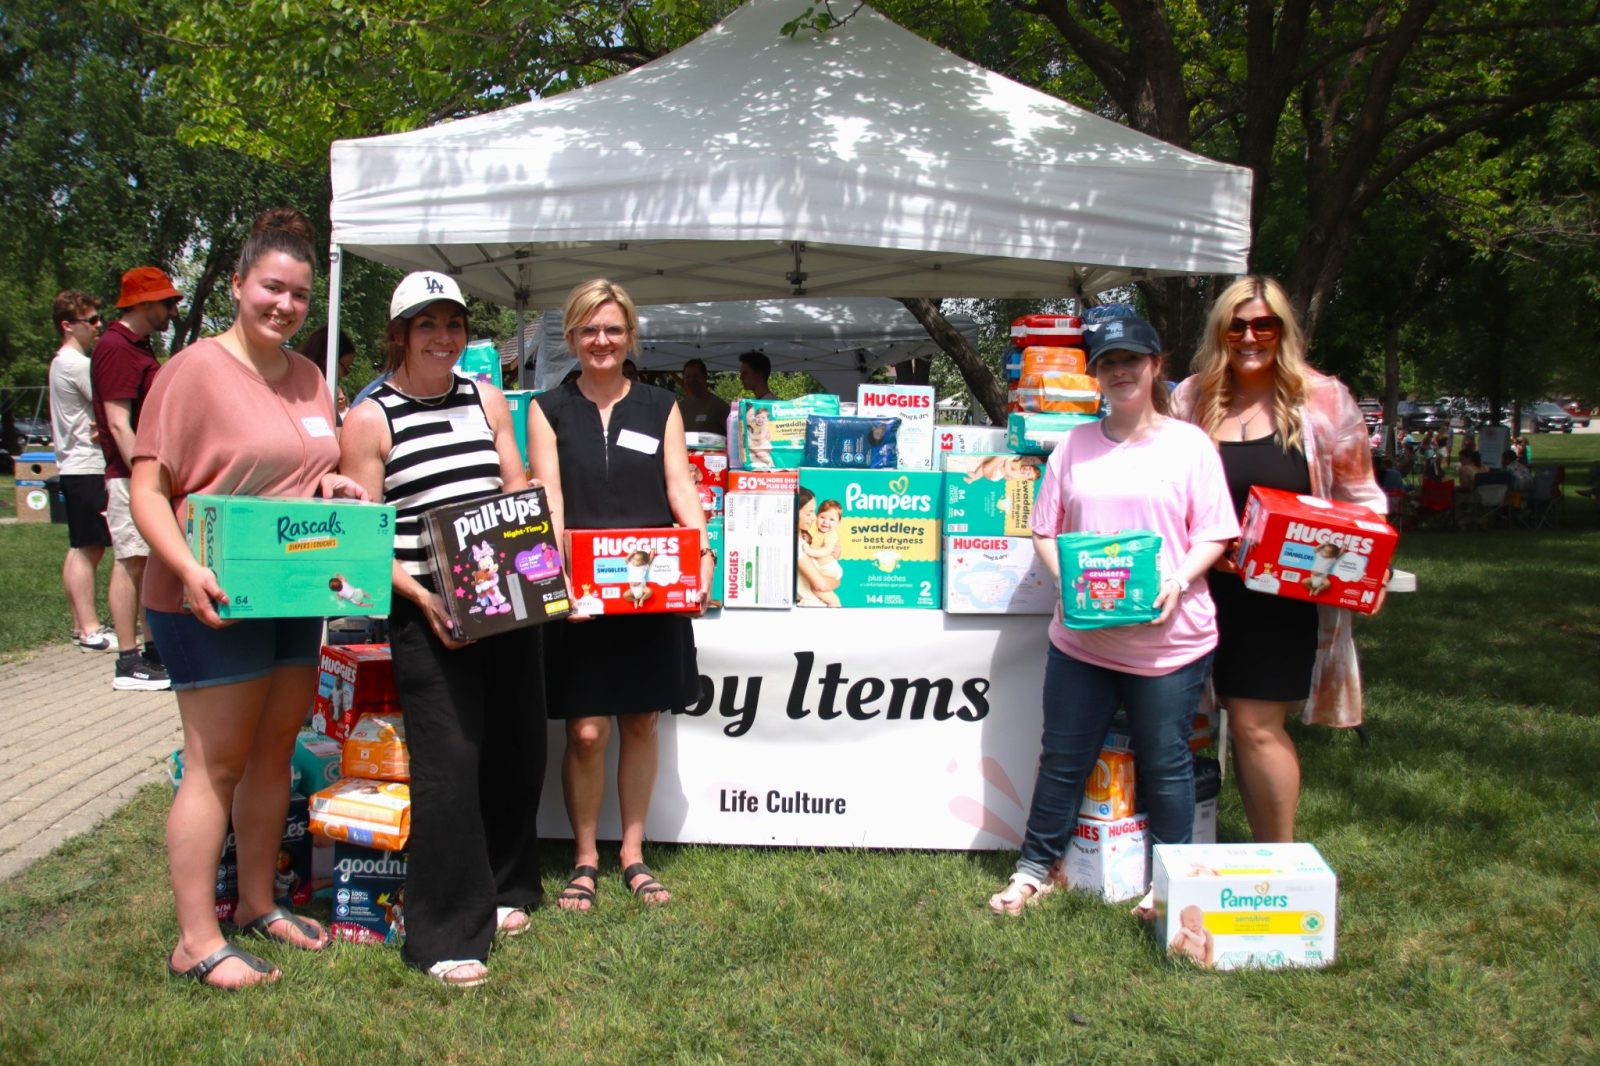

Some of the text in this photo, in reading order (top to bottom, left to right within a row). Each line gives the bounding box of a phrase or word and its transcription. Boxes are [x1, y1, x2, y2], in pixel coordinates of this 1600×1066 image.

[424, 276, 445, 294] LA
[864, 393, 930, 408] HUGGIES
[776, 421, 807, 430] swaddle
[811, 419, 828, 464] goodnites
[737, 476, 766, 489] 50%
[845, 482, 931, 515] Pampers
[1021, 480, 1030, 528] swaddlers
[277, 511, 343, 545] Rascals
[379, 513, 389, 528] 3
[850, 523, 925, 535] swaddlers
[204, 507, 218, 577] Rasca
[593, 536, 680, 556] HUGGIES
[887, 537, 924, 545] dryness
[952, 538, 1007, 550] HUGGIES
[1285, 522, 1374, 555] HUGGIES
[1078, 550, 1134, 570] Pampers
[728, 551, 739, 599] HUGGIES
[543, 592, 553, 602] 52
[685, 589, 697, 603] N
[920, 581, 932, 597] 2
[1361, 590, 1374, 604] N
[235, 595, 248, 605] 64
[866, 594, 883, 604] 144
[321, 655, 357, 684] HUGGIES
[786, 651, 990, 722] Items
[719, 789, 846, 814] Life Culture
[1109, 820, 1150, 838] HUGGIES
[334, 850, 407, 882] goodni
[1220, 888, 1288, 911] Pampers
